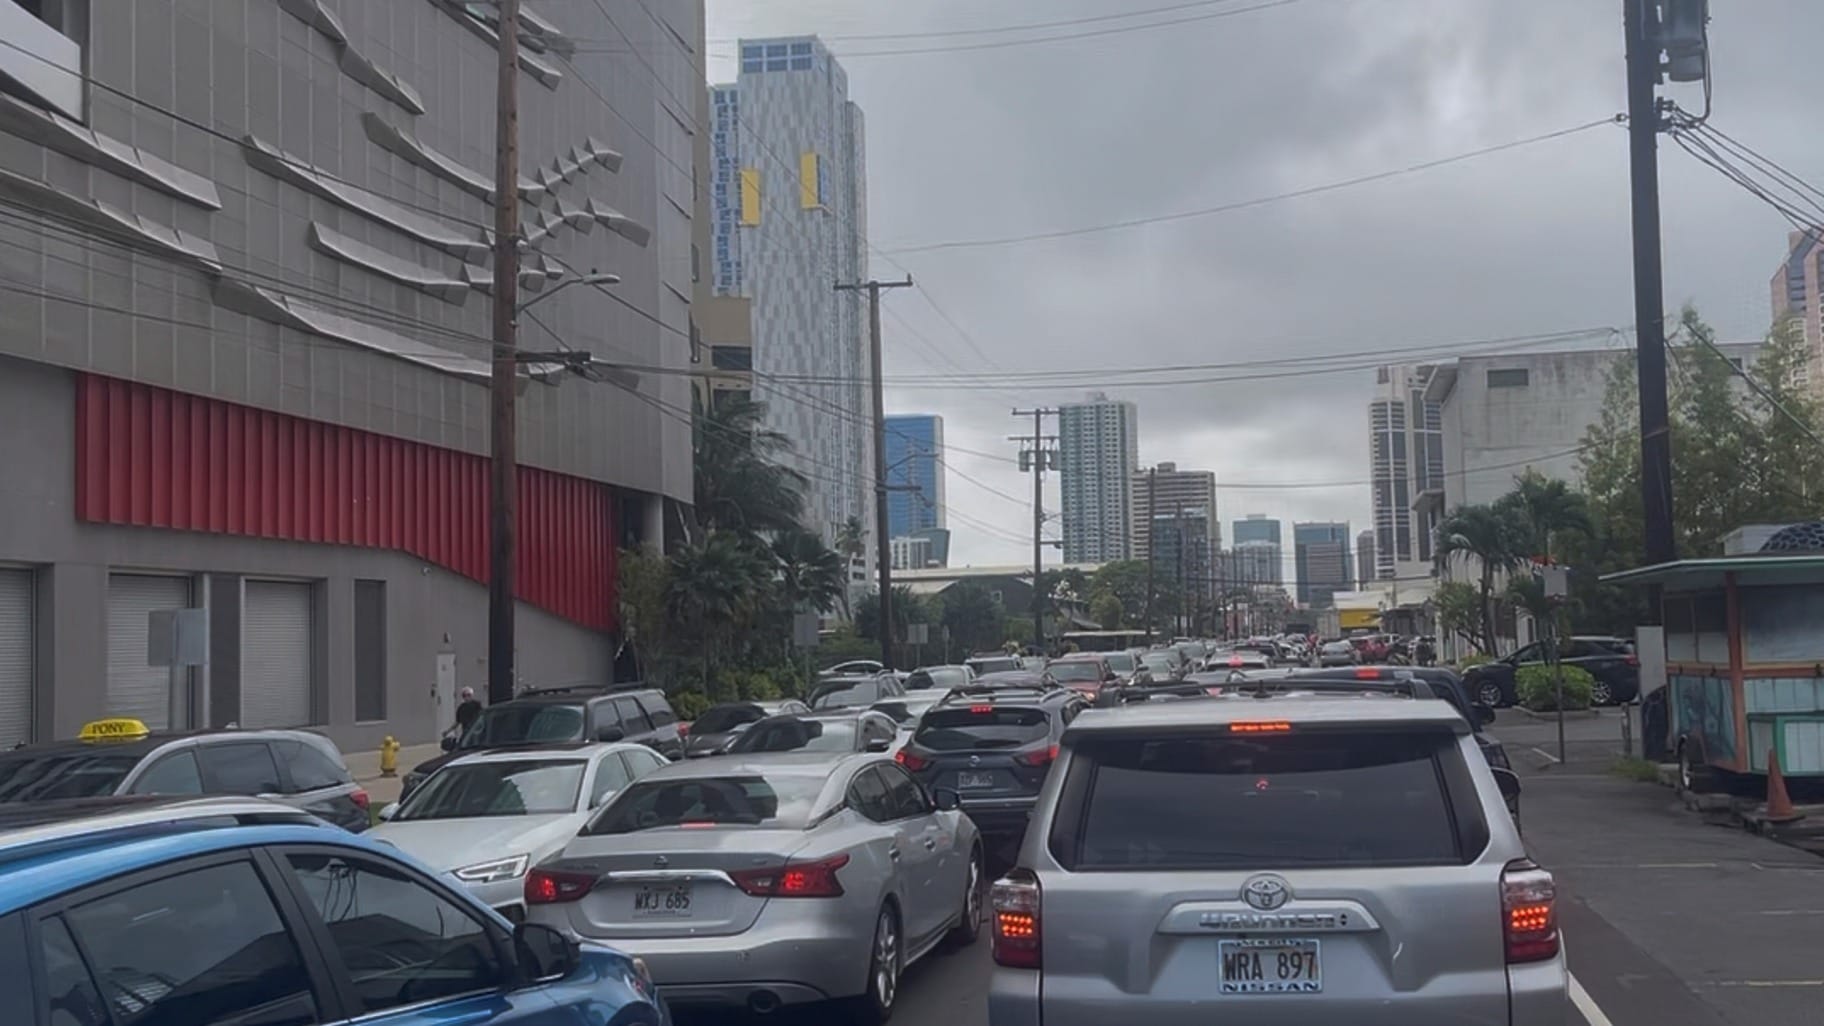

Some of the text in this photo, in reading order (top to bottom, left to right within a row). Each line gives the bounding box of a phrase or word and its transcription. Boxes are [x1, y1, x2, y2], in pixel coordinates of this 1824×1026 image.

[635, 891, 690, 910] WXJ 685
[1224, 951, 1316, 981] WRA 897
[1223, 982, 1319, 992] NISSAN
